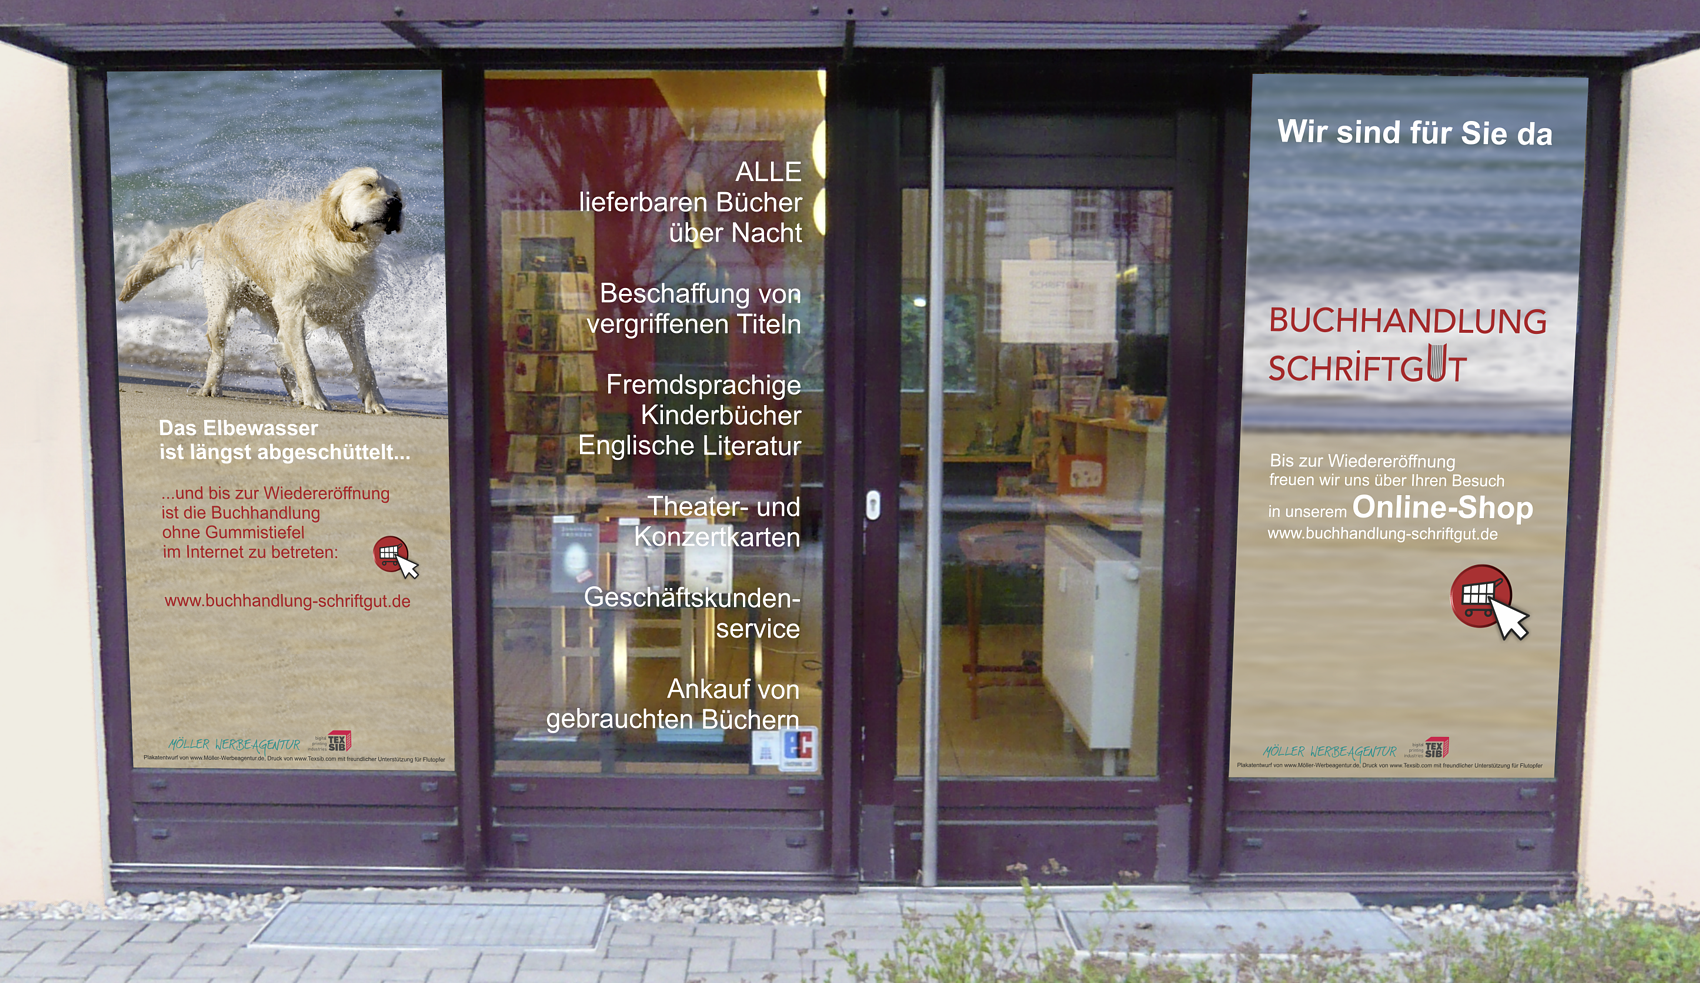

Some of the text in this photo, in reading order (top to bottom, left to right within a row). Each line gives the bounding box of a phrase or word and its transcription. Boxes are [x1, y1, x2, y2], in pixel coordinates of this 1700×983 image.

[1277, 118, 1553, 146] Wir sind für Sie da
[735, 161, 802, 182] ALLE
[579, 191, 803, 213] lieferbaren Bücher
[669, 222, 803, 243] über Nacht
[601, 283, 801, 309] Beschaffung von
[586, 313, 801, 339] vergriffenen Titeln
[1270, 306, 1547, 335] BUCHHANDLUNG
[607, 373, 802, 401] Fremdsprachige
[641, 404, 802, 426] Kinderbücher
[159, 419, 319, 437] Das Elbewasser
[160, 444, 411, 465] ist längst abgeschüttelt...
[579, 434, 802, 461] Englische Literatur
[1270, 453, 1456, 472] Bis zur Wiedereröffnung
[1269, 473, 1505, 488] freuen wir uns über Ihren Besuch
[161, 486, 390, 504] ...und bis zur Wiedereröffnung
[161, 506, 321, 523] ist die Buchhandlung
[647, 496, 800, 517] Theater- und
[1268, 494, 1534, 526] in unserem Online-Shop
[162, 525, 305, 540] ohne Gummistiefel
[635, 526, 800, 547] Konzertkarten
[1267, 527, 1499, 544] www.buchhandlung-schriftgut.de
[163, 545, 339, 560] im Internet zu betreten:
[164, 593, 411, 611] www.buchhandlung-schriftgut.de
[584, 586, 801, 609] Geschäftskunden-
[716, 618, 801, 639] service
[666, 678, 800, 700] Ankauf von
[546, 708, 800, 734] gebrauchten Büchern
[168, 736, 301, 757] MÖLLER WERBEAGENTUR
[328, 736, 346, 744] TEX
[328, 744, 346, 752] SIB
[1425, 742, 1443, 750] TEX
[378, 756, 414, 764] Unterstützung
[1262, 744, 1397, 764] MÖLLER WERBEAGENTUR
[1425, 750, 1443, 758] SIB
[1474, 762, 1511, 770] Unterstützung
[1519, 762, 1543, 770] Flutopfer
